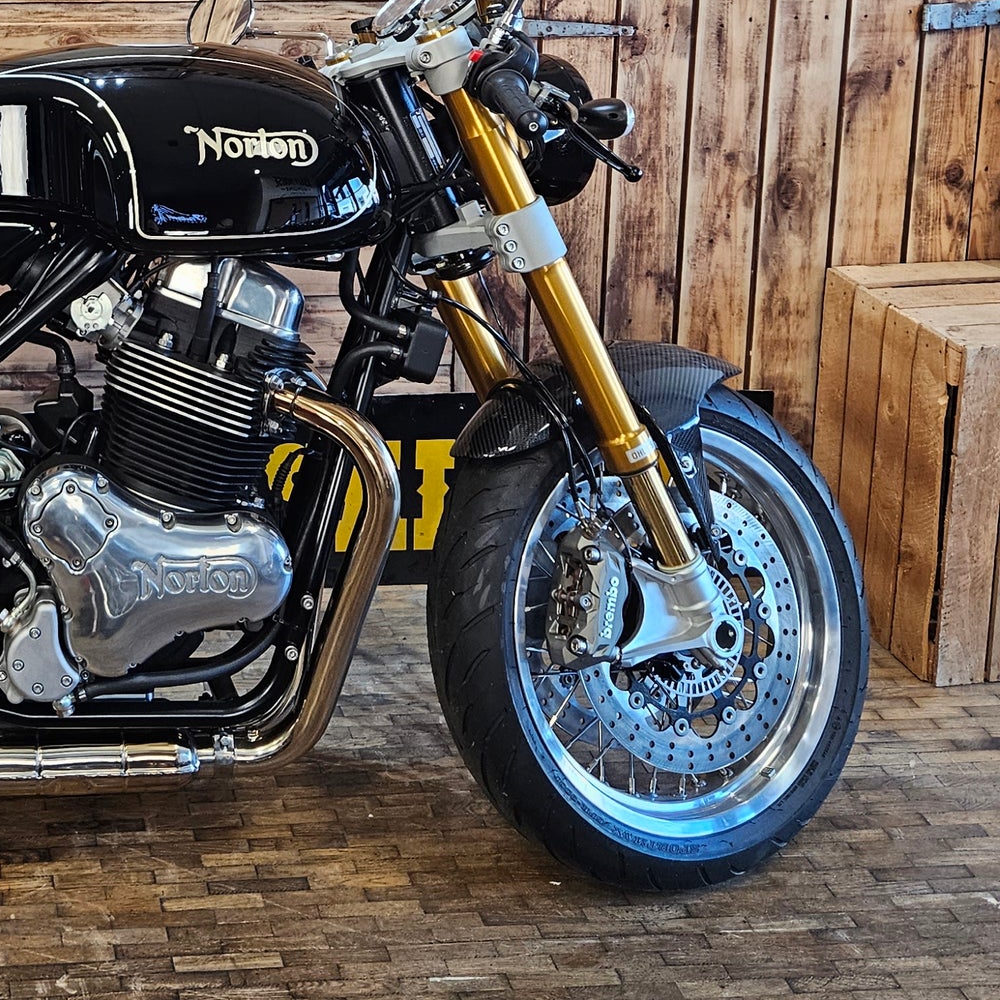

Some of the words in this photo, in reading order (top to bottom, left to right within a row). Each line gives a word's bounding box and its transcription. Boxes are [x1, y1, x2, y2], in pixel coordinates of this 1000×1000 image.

[183, 125, 319, 167] Norton
[131, 555, 259, 600] Norton
[599, 576, 620, 640] brembo
